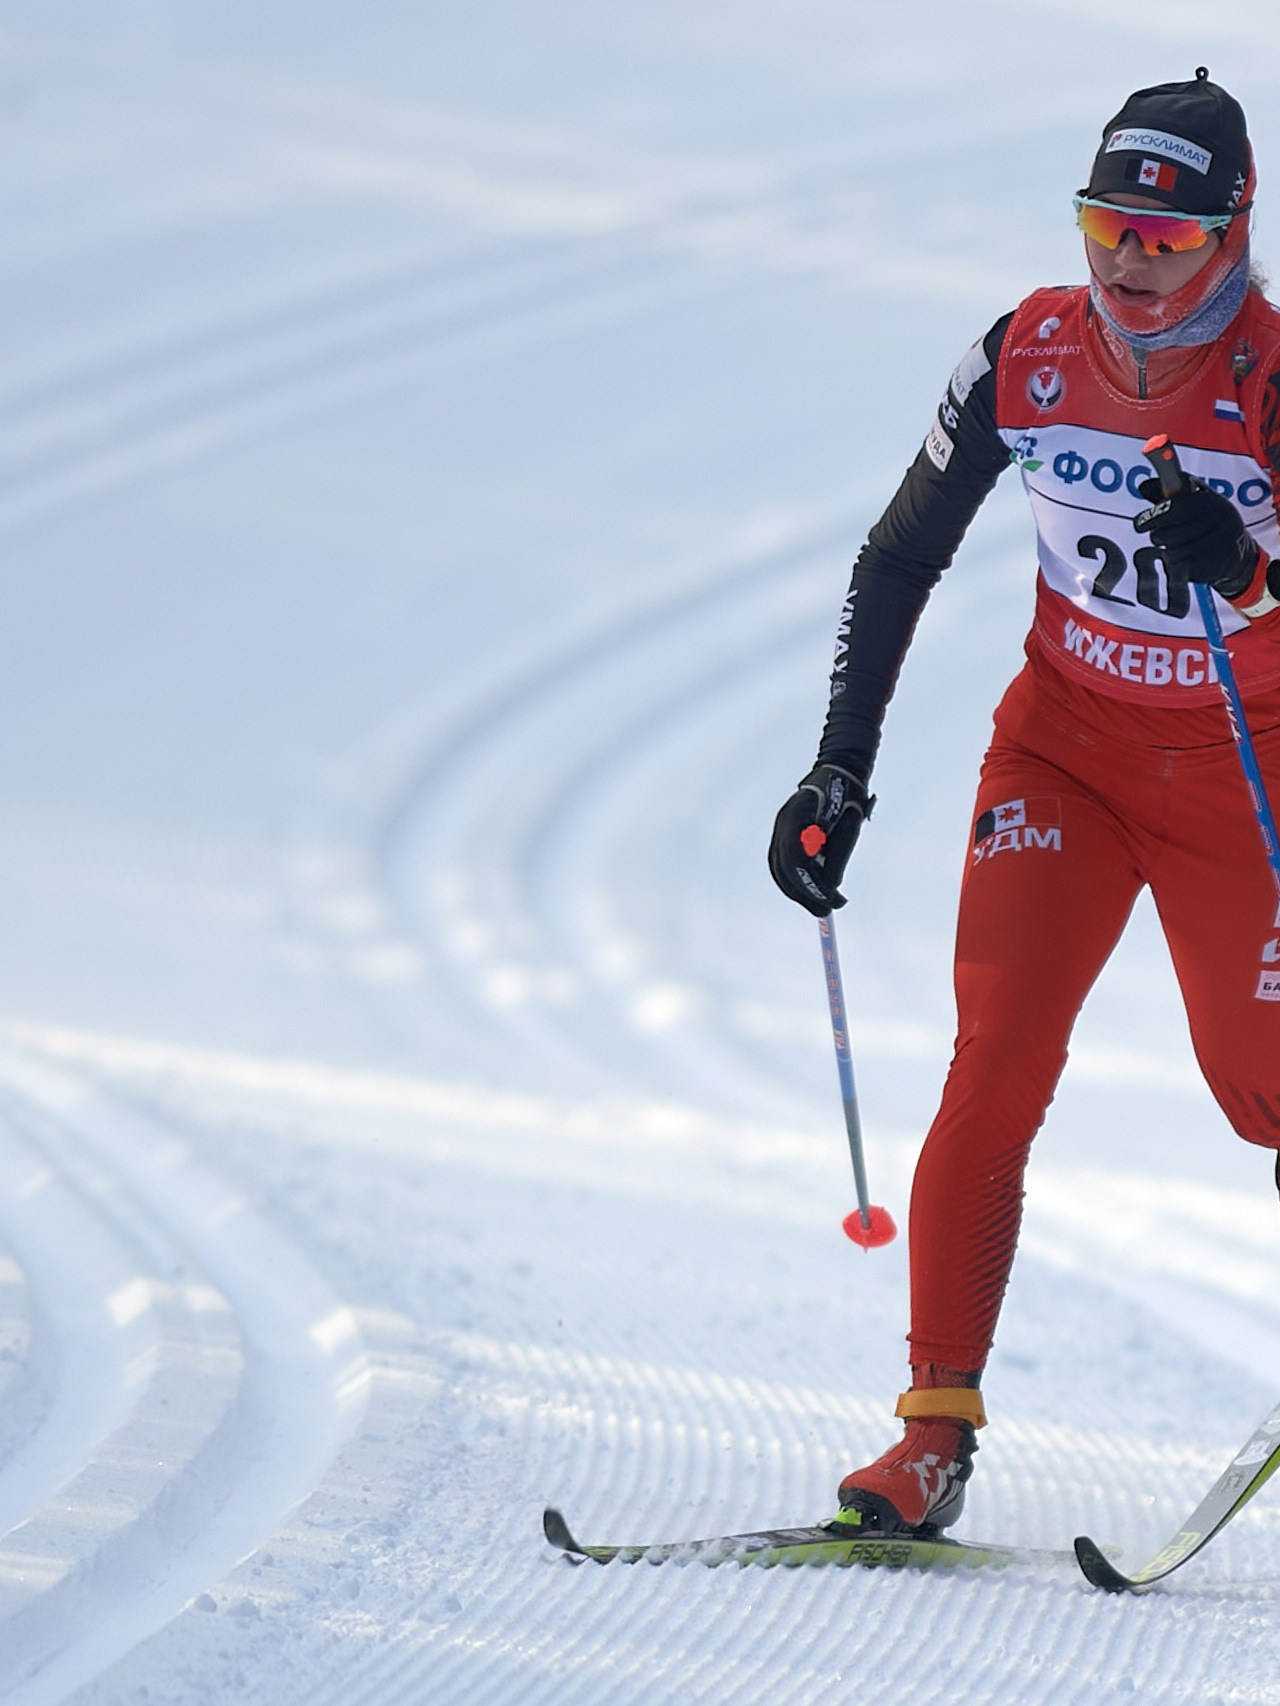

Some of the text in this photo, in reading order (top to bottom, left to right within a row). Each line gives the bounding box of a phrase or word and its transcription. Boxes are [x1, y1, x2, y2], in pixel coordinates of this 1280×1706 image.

[1124, 133, 1209, 167] РУСКЛИМАТ
[1011, 343, 1083, 357] РУСКЛИМАТ
[1052, 449, 1271, 507] ФОСРО
[1077, 534, 1191, 619] 20
[974, 827, 1062, 866] УДМ
